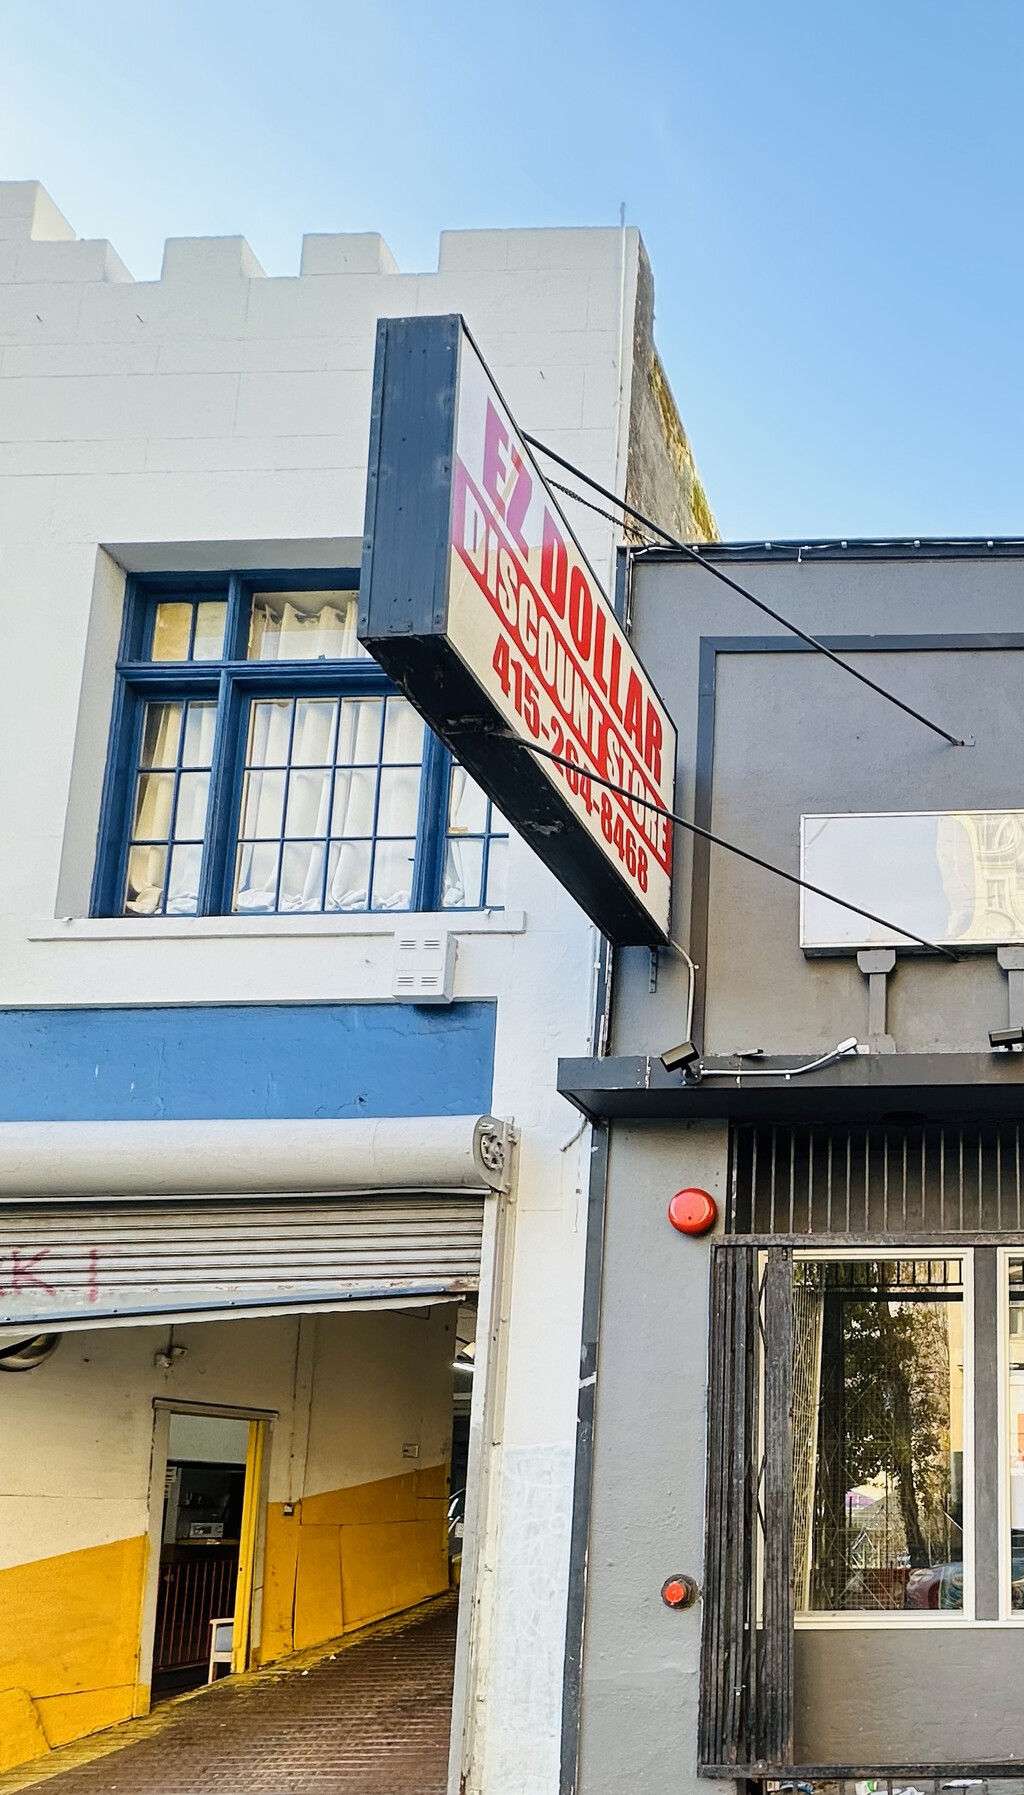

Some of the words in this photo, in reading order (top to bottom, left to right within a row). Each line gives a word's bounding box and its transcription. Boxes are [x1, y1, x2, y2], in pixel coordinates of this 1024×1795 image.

[463, 485, 603, 763] DISCOUNT
[604, 729, 668, 864] STORE
[482, 396, 533, 562] EZ
[539, 506, 664, 786] DOLLAR
[492, 633, 649, 894] 415-264-8468
